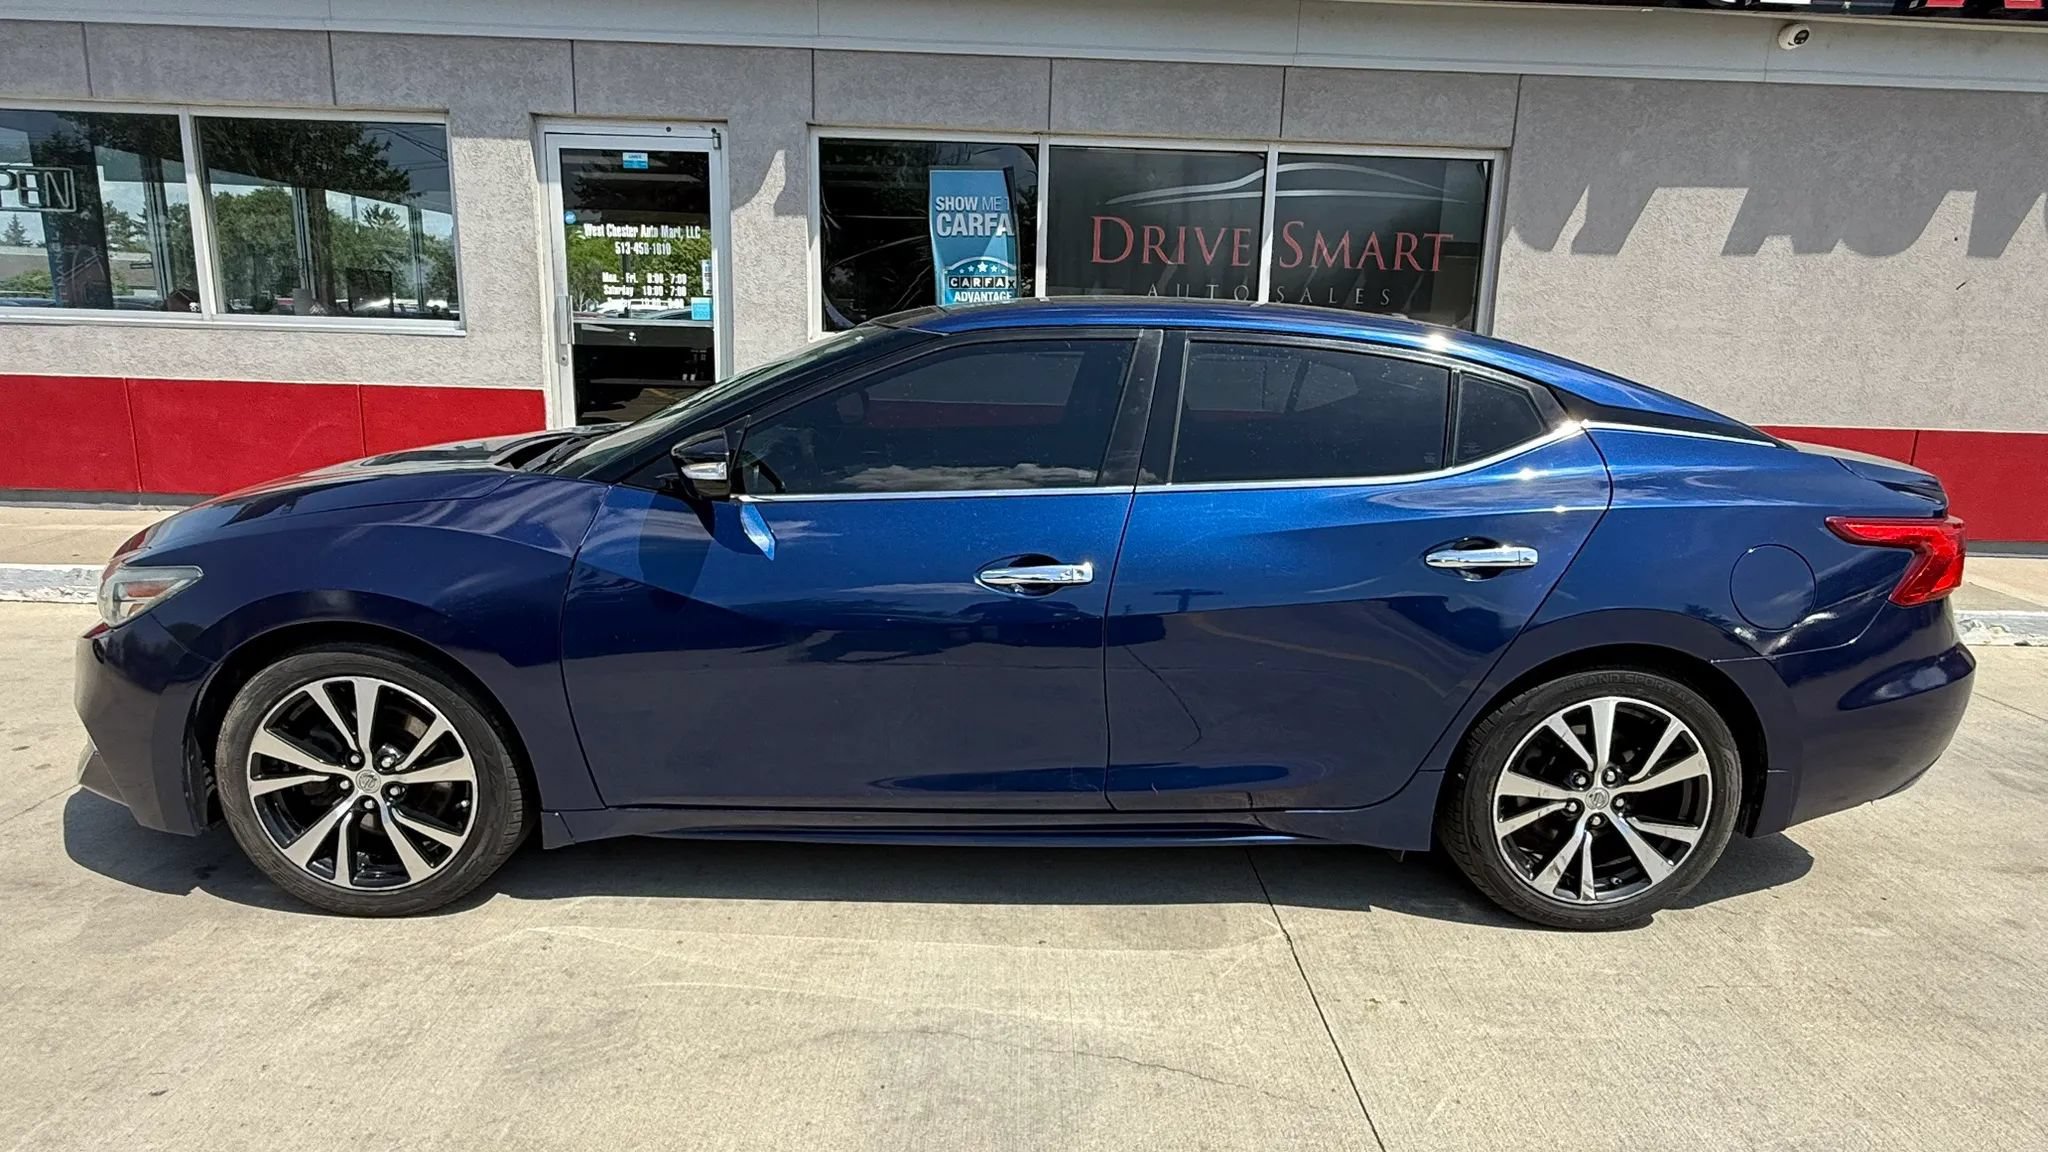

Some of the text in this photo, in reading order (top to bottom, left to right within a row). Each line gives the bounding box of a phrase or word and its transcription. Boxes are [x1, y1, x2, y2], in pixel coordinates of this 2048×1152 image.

[0, 170, 70, 208] PEN
[935, 195, 978, 212] SHOW
[982, 196, 1001, 210] ME
[584, 223, 604, 237] West
[605, 223, 639, 238] Chester
[640, 224, 659, 238] Auto
[686, 225, 701, 239] LLC
[936, 212, 1015, 237] CARFA
[603, 284, 634, 297] Saturday
[669, 285, 687, 297] 7:00
[950, 277, 1016, 289] CARFAX
[954, 291, 1013, 303] ADVANTAGE
[1147, 284, 1391, 306] AUTO SALES
